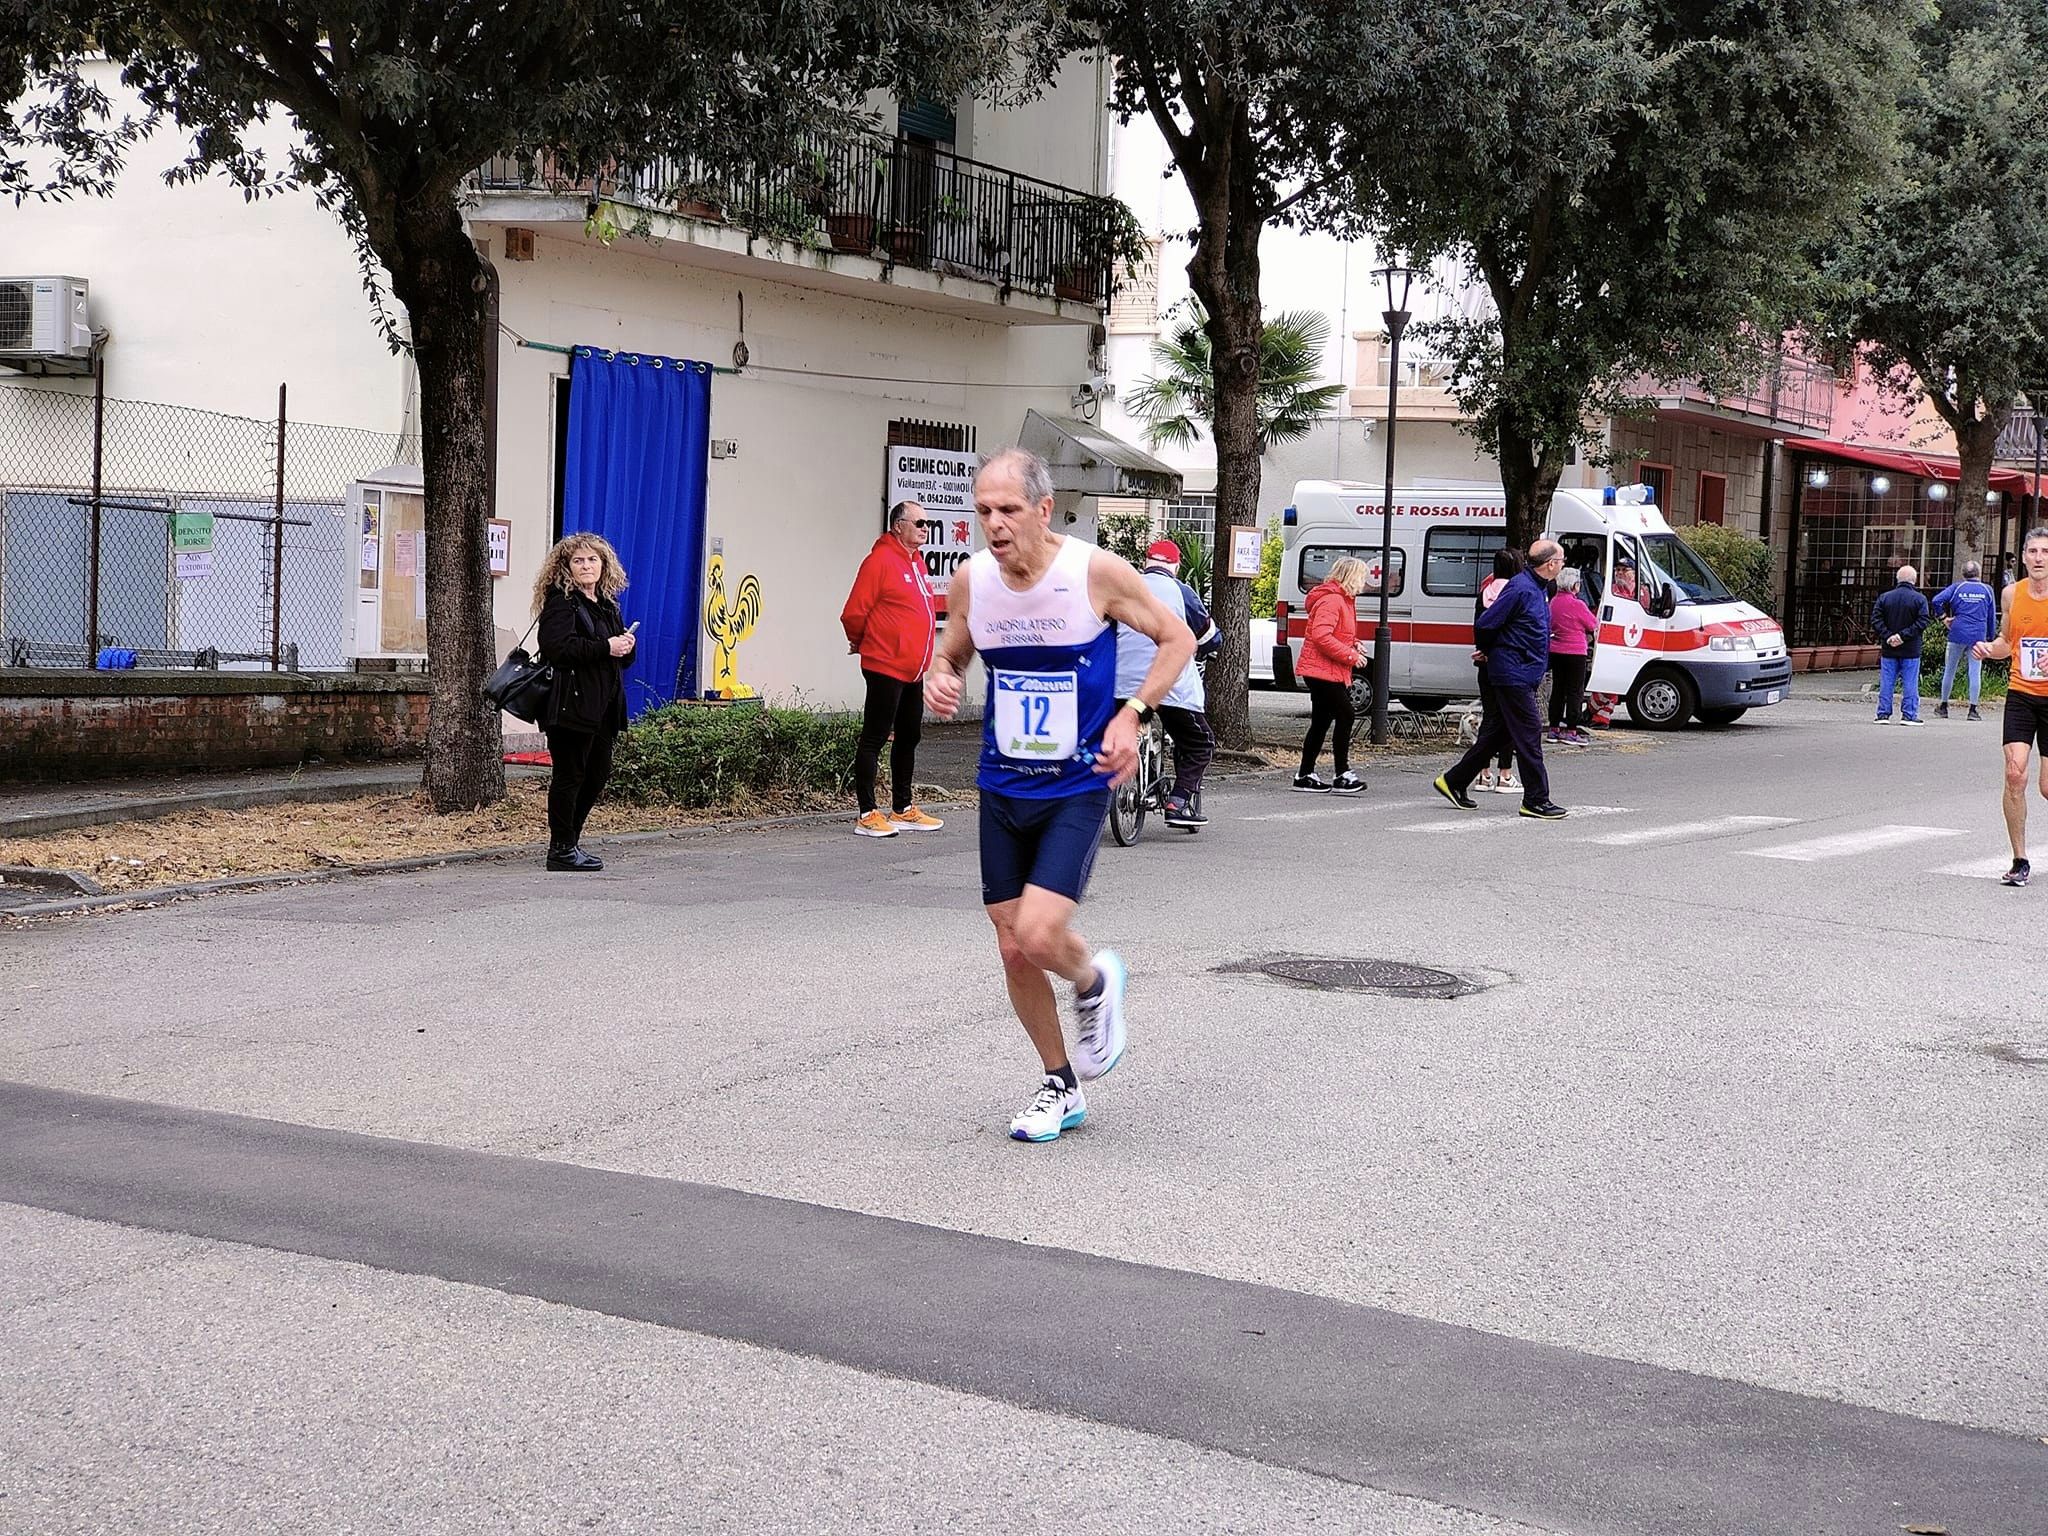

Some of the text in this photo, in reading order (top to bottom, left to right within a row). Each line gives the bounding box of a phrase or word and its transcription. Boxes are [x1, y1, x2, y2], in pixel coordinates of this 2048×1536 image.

[726, 442, 737, 455] 68
[1409, 506, 1460, 517] ROSSA
[1465, 506, 1506, 518] ITALI
[178, 527, 211, 536] DEPOSITO
[183, 537, 206, 546] BORSE
[920, 551, 971, 578] arc
[984, 618, 1067, 634] QUADRILATERO
[1020, 695, 1050, 736] 12
